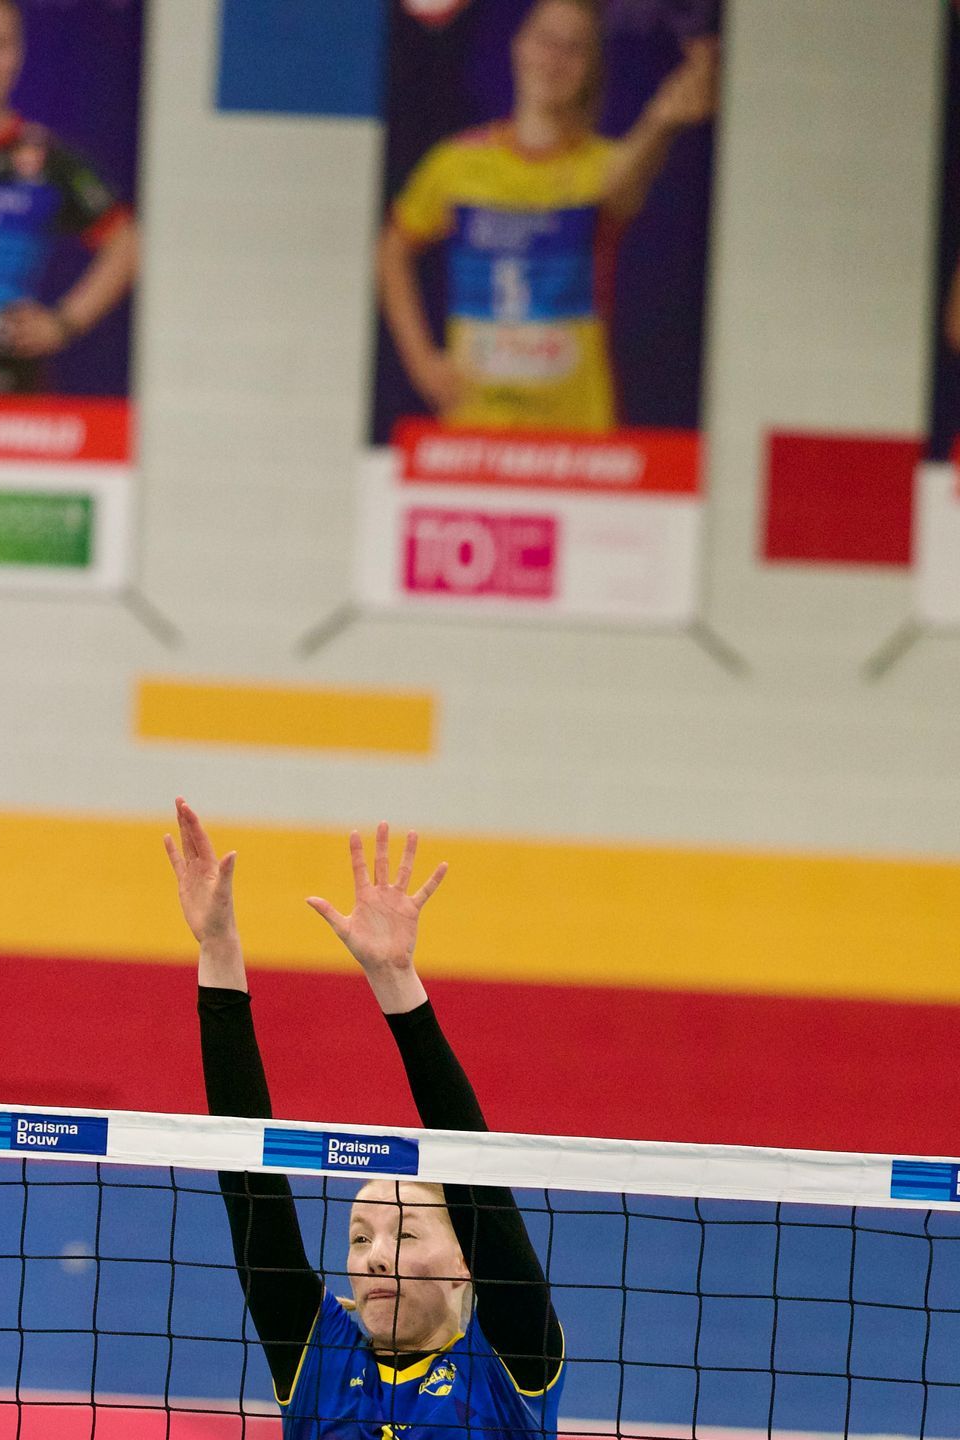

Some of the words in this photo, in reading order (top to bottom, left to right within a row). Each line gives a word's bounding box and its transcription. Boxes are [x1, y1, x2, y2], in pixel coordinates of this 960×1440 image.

[16, 1119, 79, 1136] Draisma
[16, 1131, 59, 1147] Bouw
[328, 1138, 390, 1155] Draisma
[327, 1151, 371, 1166] Bouw
